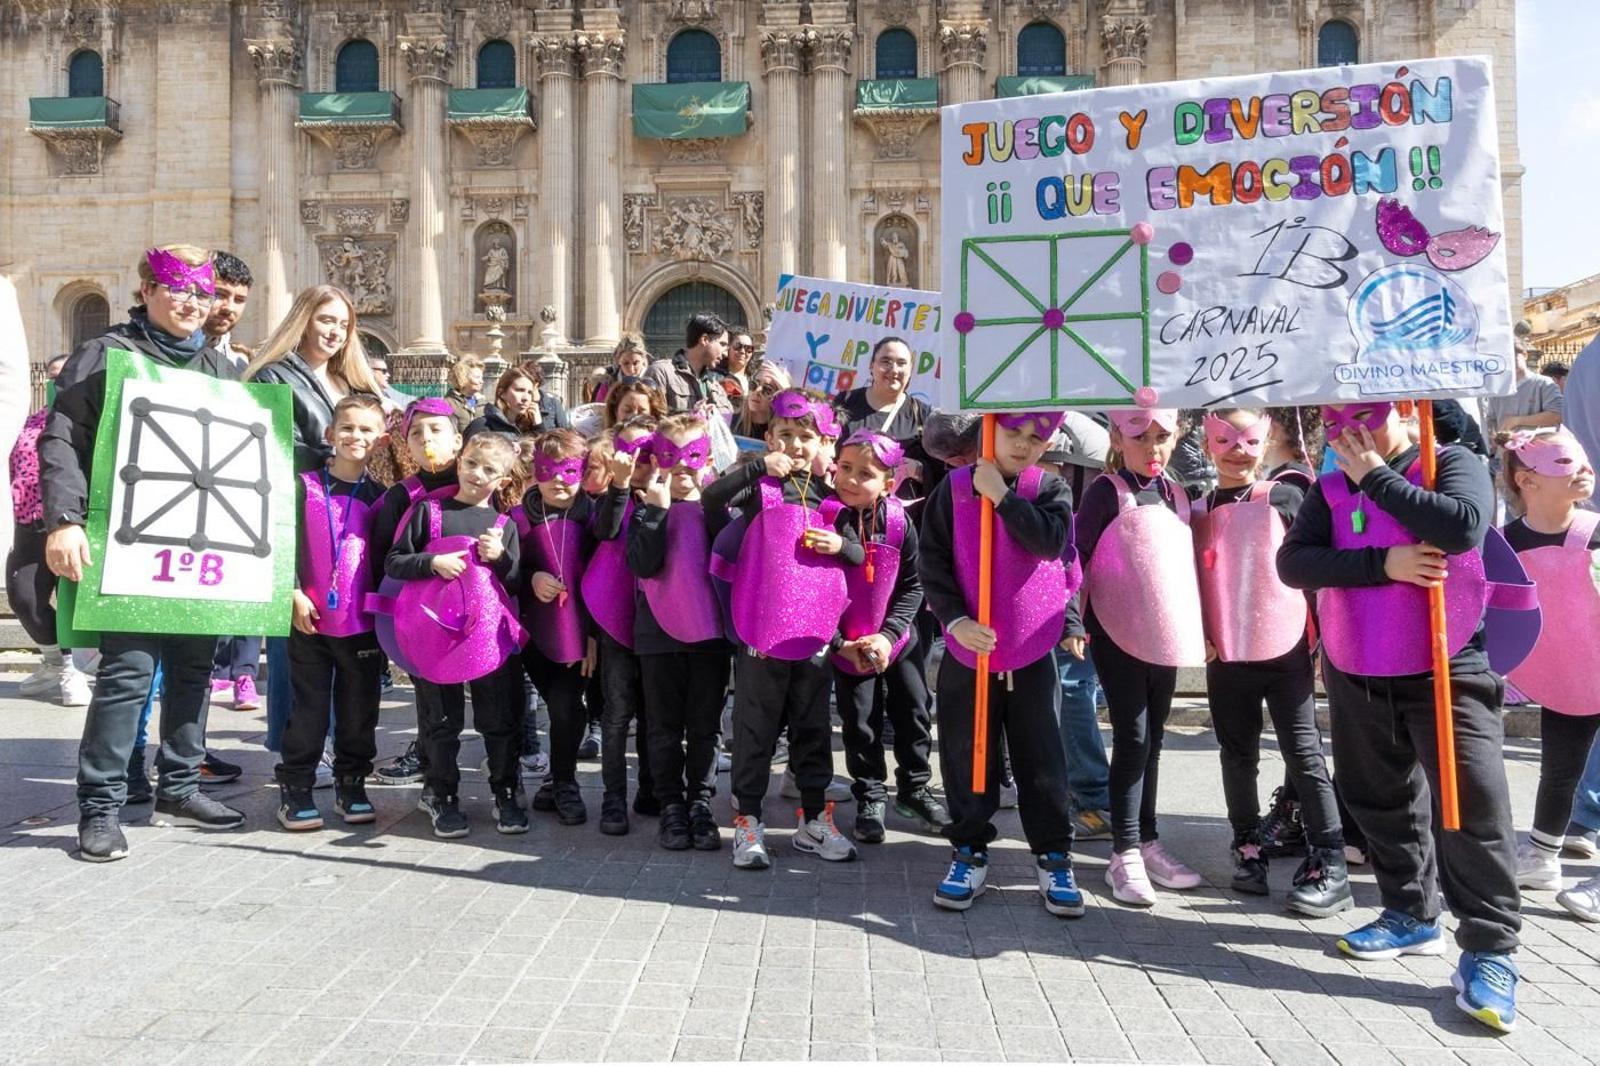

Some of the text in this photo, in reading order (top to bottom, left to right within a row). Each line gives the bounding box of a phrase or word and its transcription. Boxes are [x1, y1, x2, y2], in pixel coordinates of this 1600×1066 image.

[962, 65, 1453, 165] JUEGO Y DIVERSIÓN
[1036, 170, 1121, 220] QUE
[1146, 136, 1398, 210] EMOCIÓN
[1408, 145, 1443, 191] !!
[805, 331, 830, 359] Y
[1159, 304, 1301, 345] CARNAVAL
[1184, 340, 1279, 387] 2025
[1341, 358, 1499, 381] DIVINO MAESTRO
[152, 549, 224, 586] 1ºB
